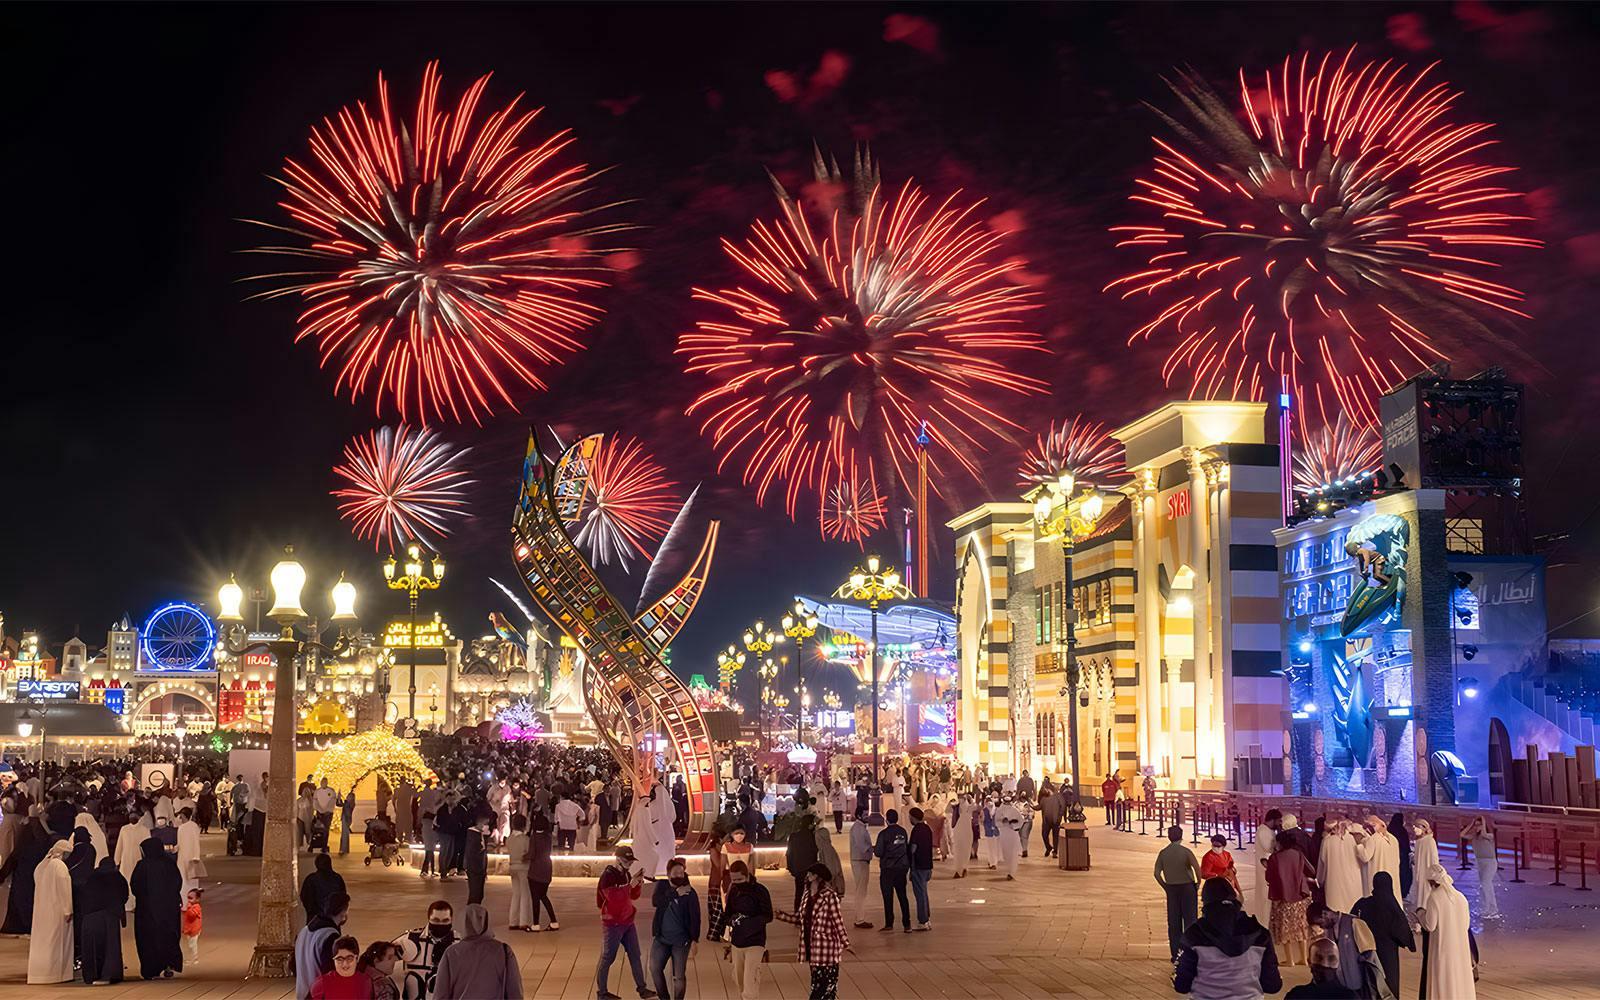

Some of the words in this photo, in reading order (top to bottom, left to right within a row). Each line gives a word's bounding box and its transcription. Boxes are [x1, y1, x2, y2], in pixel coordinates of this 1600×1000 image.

[1386, 419, 1417, 451] FORCE
[1167, 488, 1191, 521] SYRI
[247, 656, 270, 665] IRAQ
